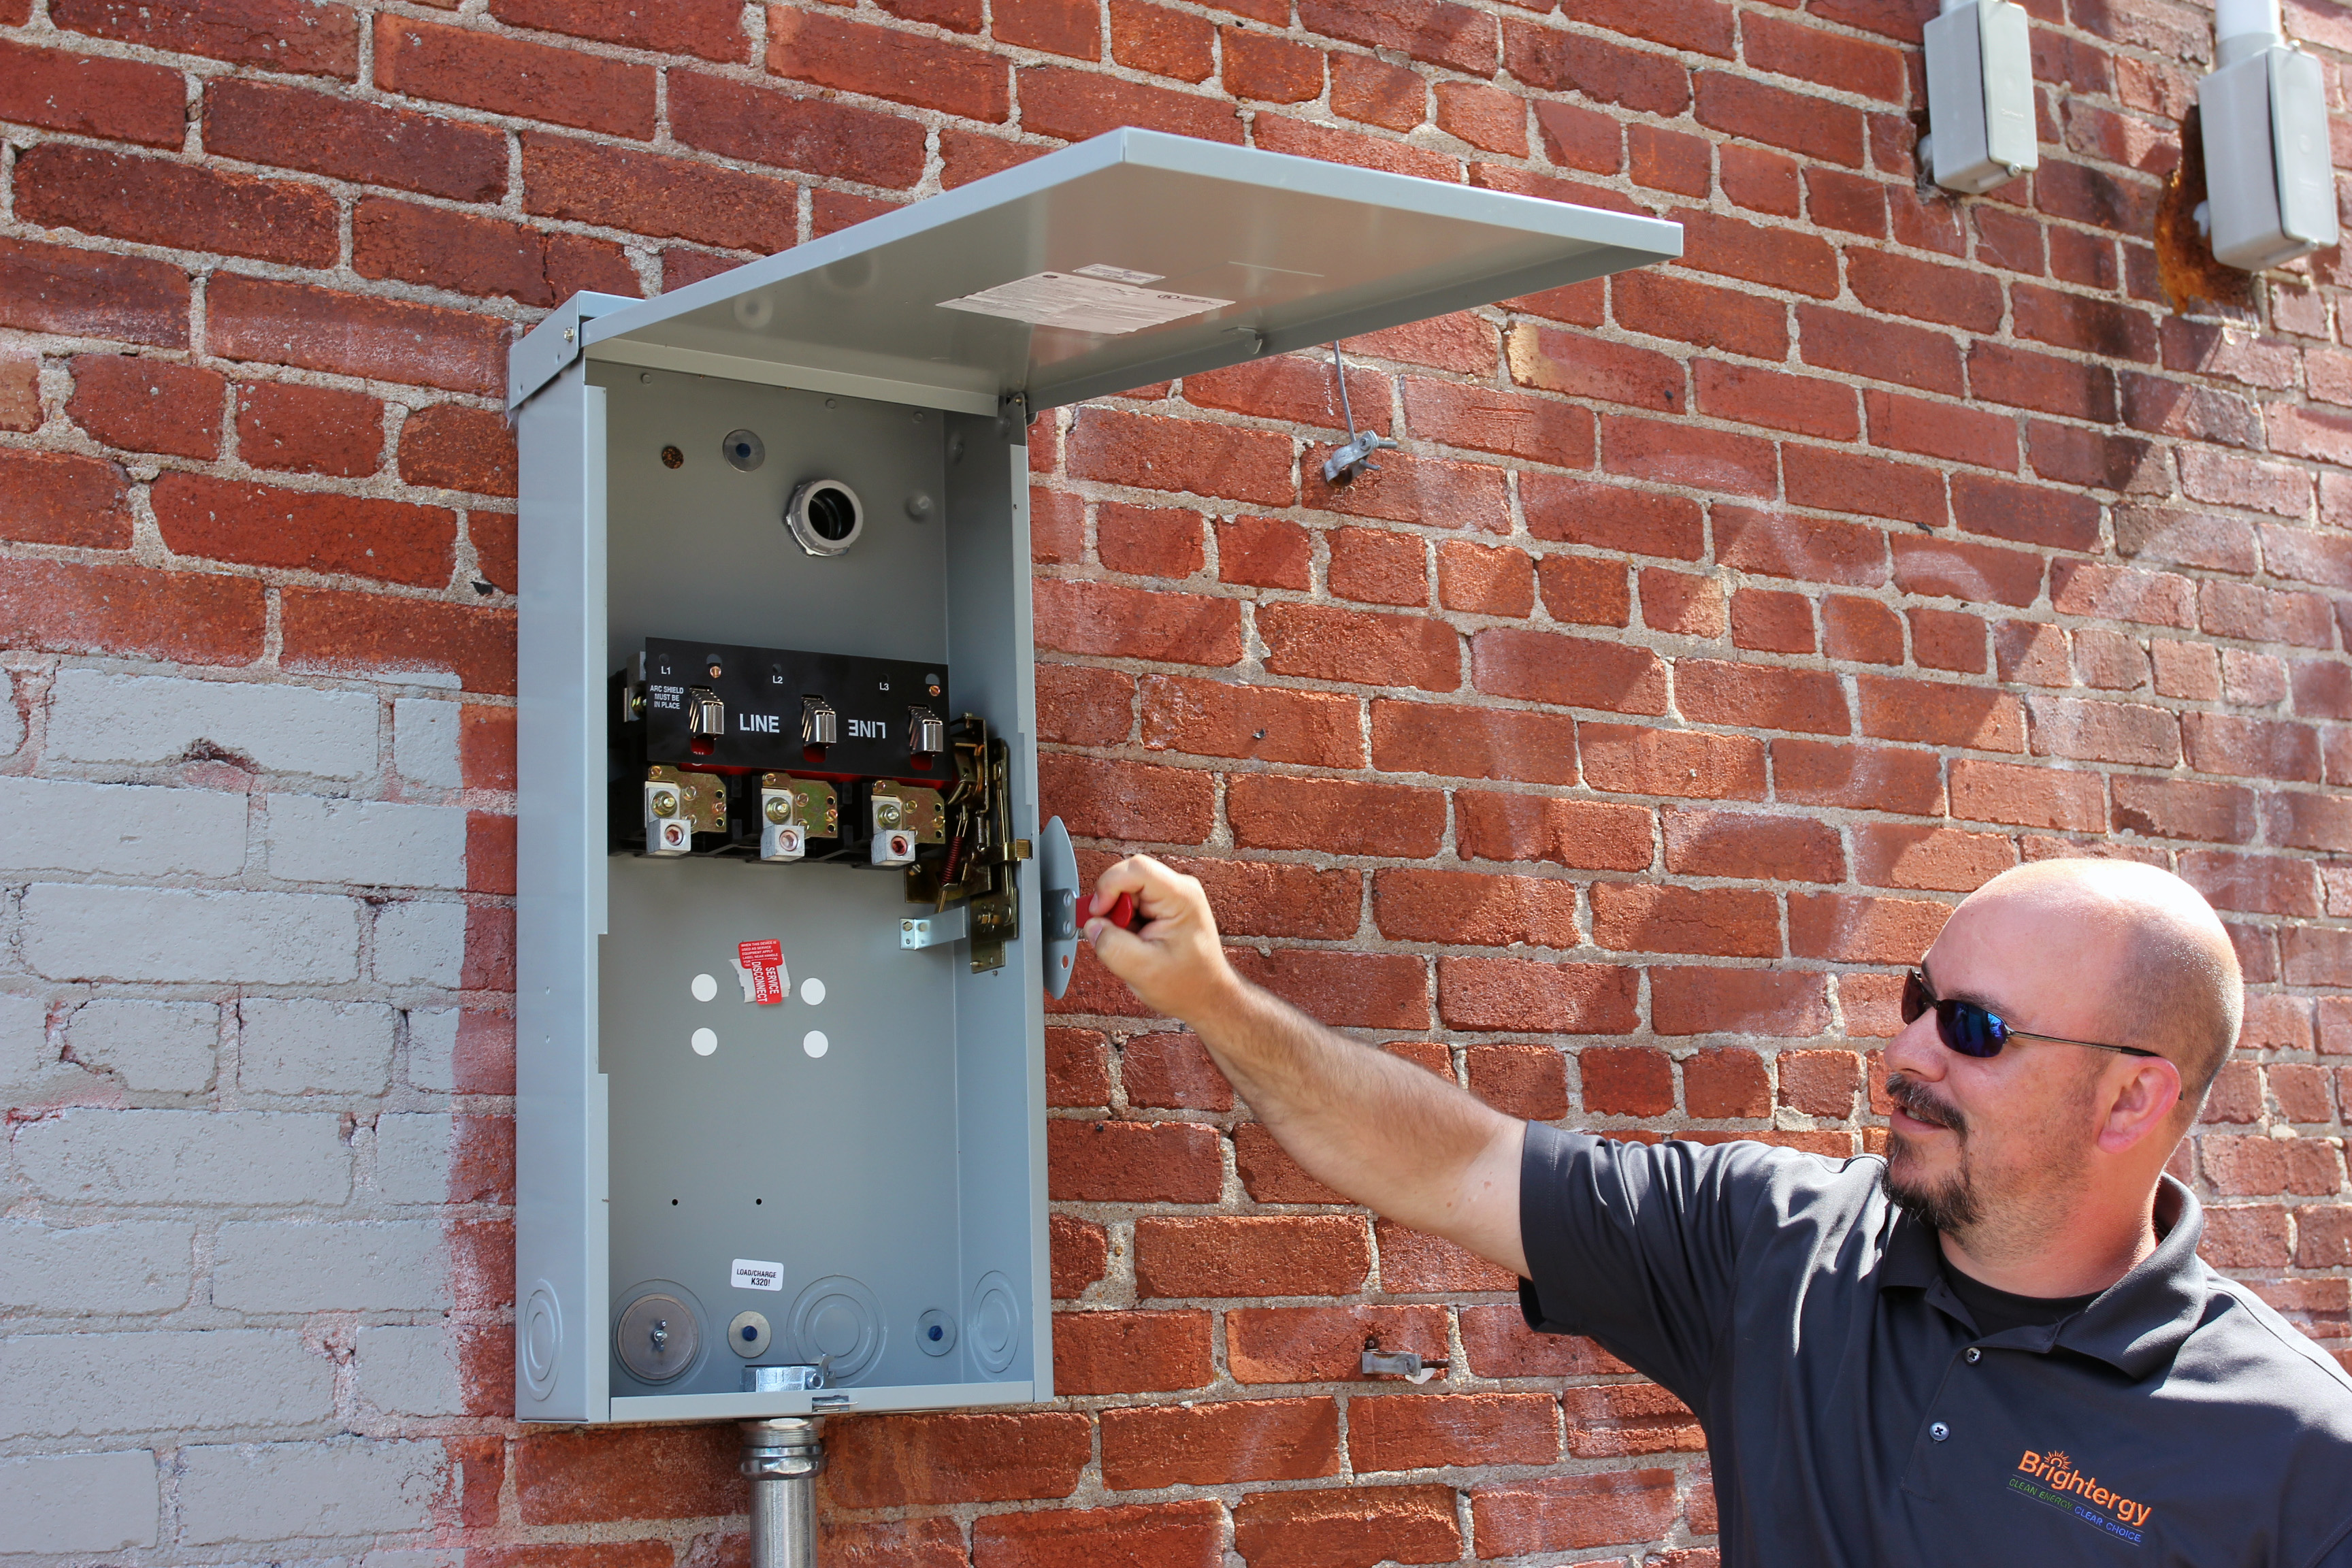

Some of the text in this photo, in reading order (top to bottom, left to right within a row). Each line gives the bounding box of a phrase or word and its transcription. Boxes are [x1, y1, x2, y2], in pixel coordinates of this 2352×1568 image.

[661, 666, 670, 674] L1
[772, 675, 783, 684] L2
[663, 686, 684, 694] SHIELD
[879, 682, 889, 691] L3
[739, 713, 780, 733] LINE
[848, 719, 886, 739] LINE
[751, 962, 768, 1002] DISCONNECT
[766, 967, 779, 994] SERVICE
[736, 1269, 777, 1278] LOAD/CHARGE
[2017, 1450, 2153, 1526] Brightergy
[2009, 1478, 2037, 1495] CLEAN
[2074, 1506, 2104, 1526] CLEAR
